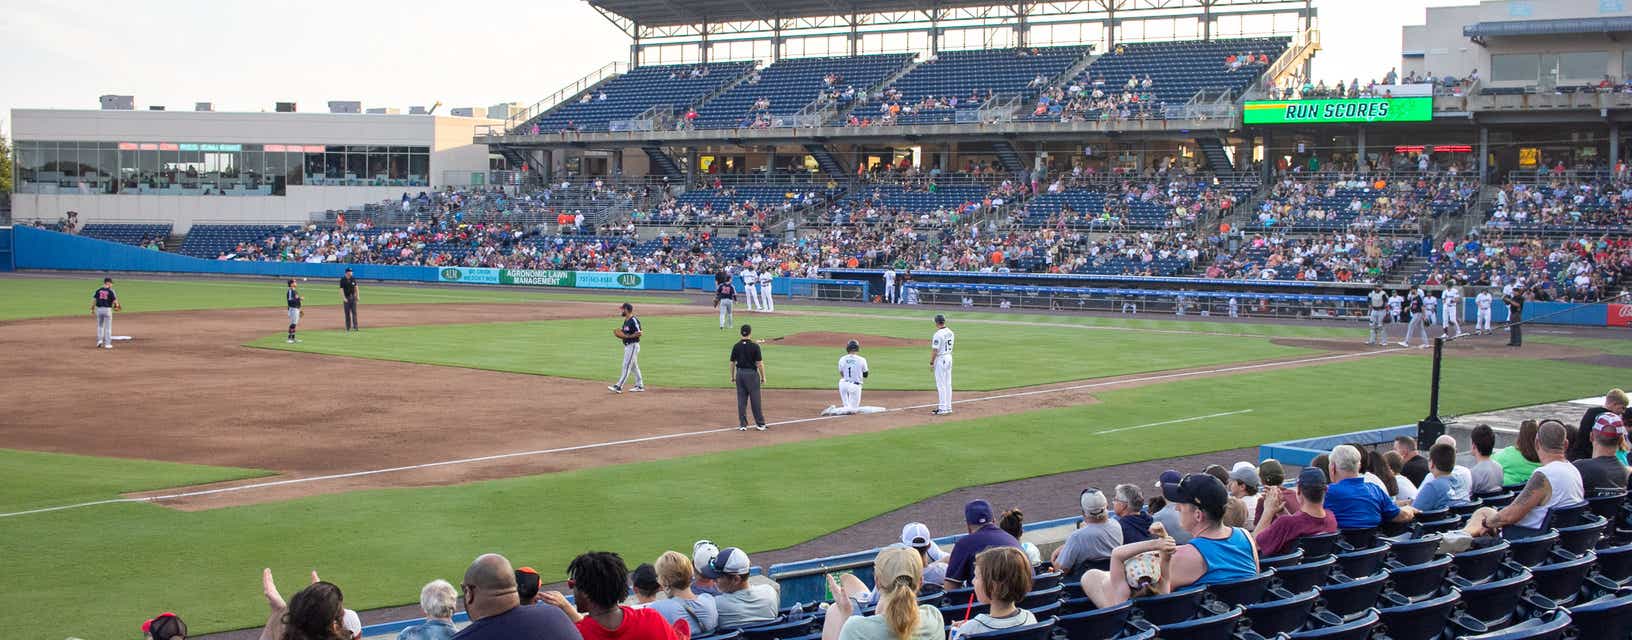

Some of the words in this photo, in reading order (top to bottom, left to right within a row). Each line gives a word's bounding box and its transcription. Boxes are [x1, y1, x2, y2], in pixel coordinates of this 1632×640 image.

[1286, 105, 1318, 119] RUN
[1323, 102, 1389, 118] SCORES
[446, 269, 458, 279] ALM
[506, 270, 547, 278] AGRONOMIC
[548, 271, 568, 279] LAWN
[513, 277, 560, 285] MANAGEMENT
[623, 275, 636, 285] ALM
